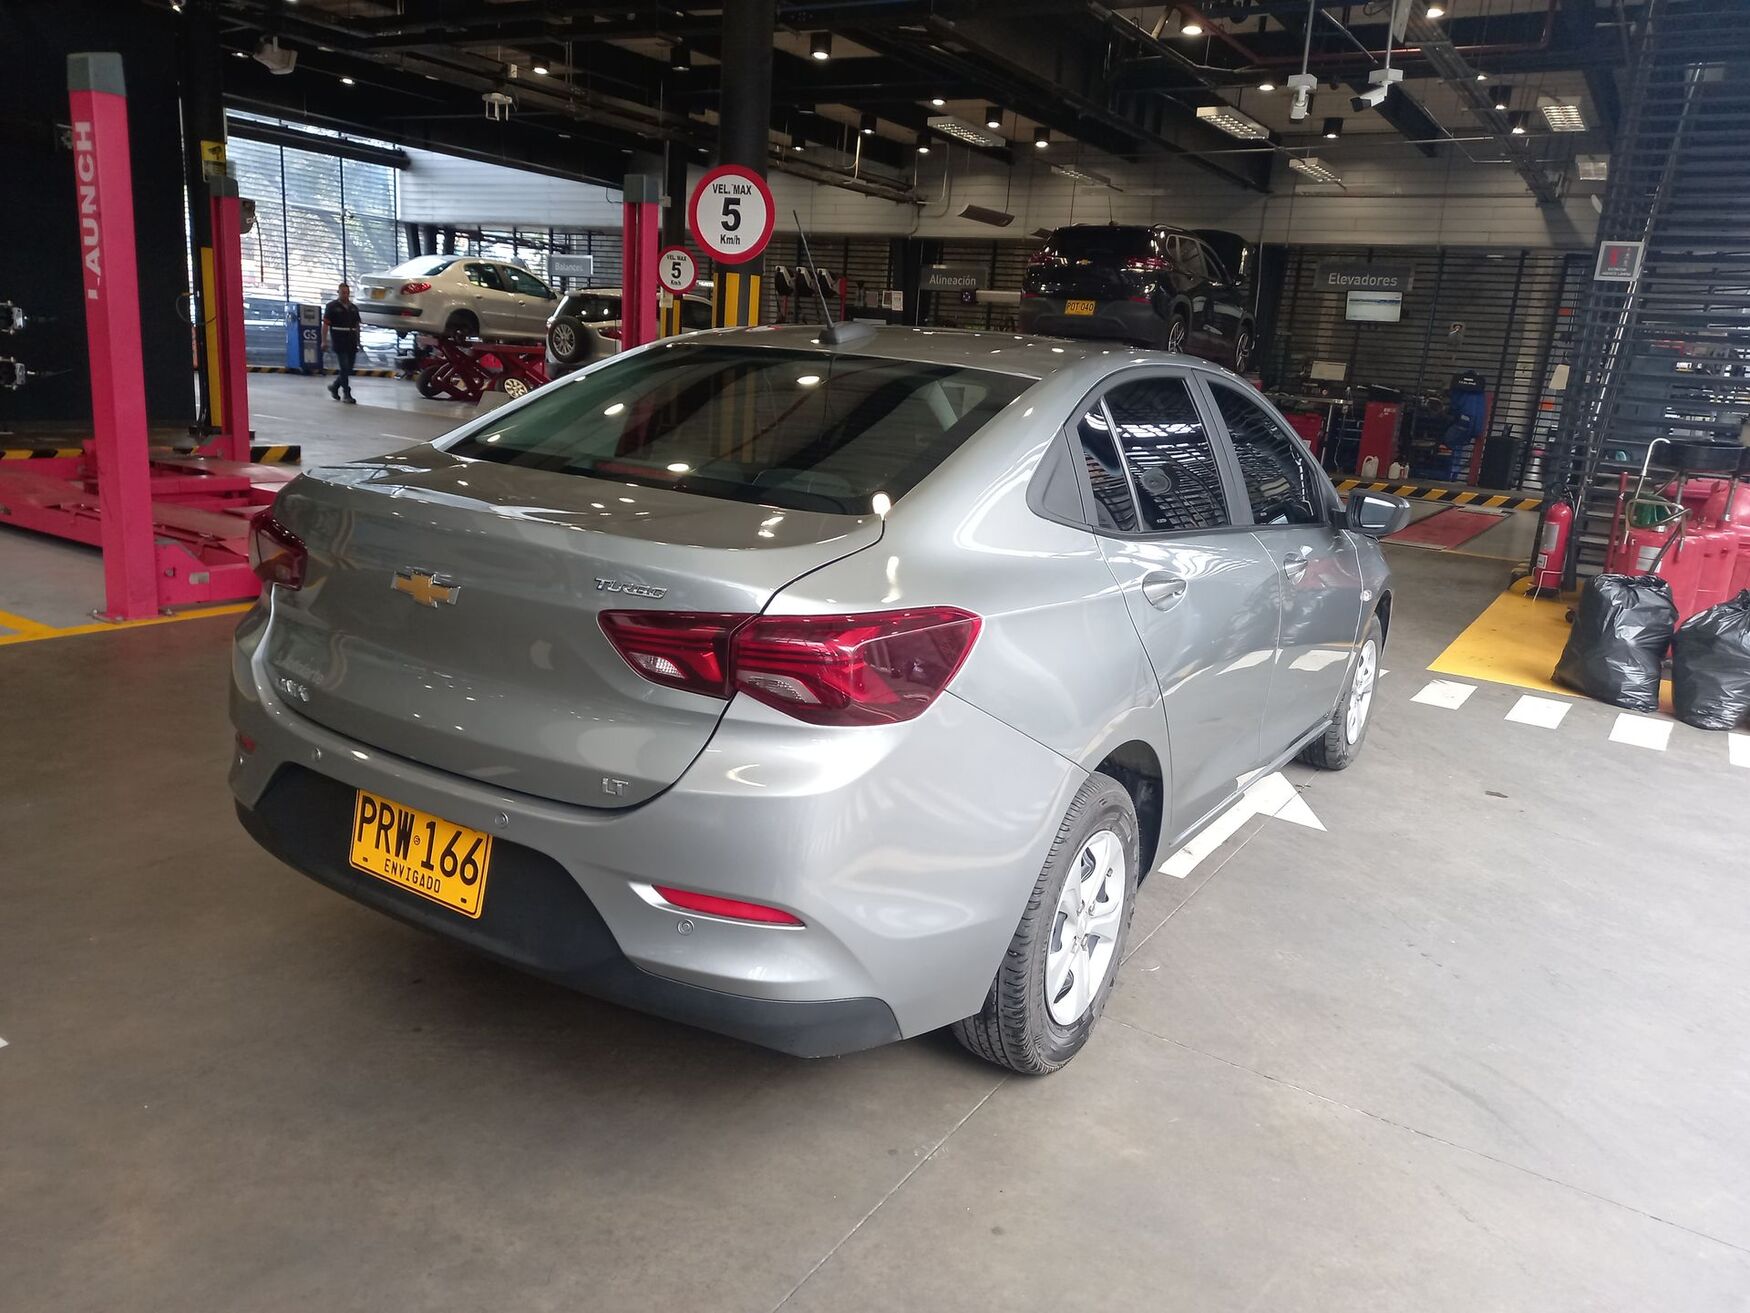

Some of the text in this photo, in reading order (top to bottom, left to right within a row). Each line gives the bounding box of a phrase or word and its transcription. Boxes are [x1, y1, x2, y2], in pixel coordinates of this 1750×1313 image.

[712, 184, 752, 196] VEL. MAX
[720, 197, 742, 232] 5
[720, 234, 741, 245] Km/h
[671, 261, 682, 279] 5
[1328, 272, 1398, 287] Elevadores
[929, 274, 977, 287] Alineación
[594, 577, 668, 600] TURBO
[602, 776, 629, 798] LT
[357, 794, 484, 887] PRW 166
[384, 858, 441, 894] ENVIGADO
